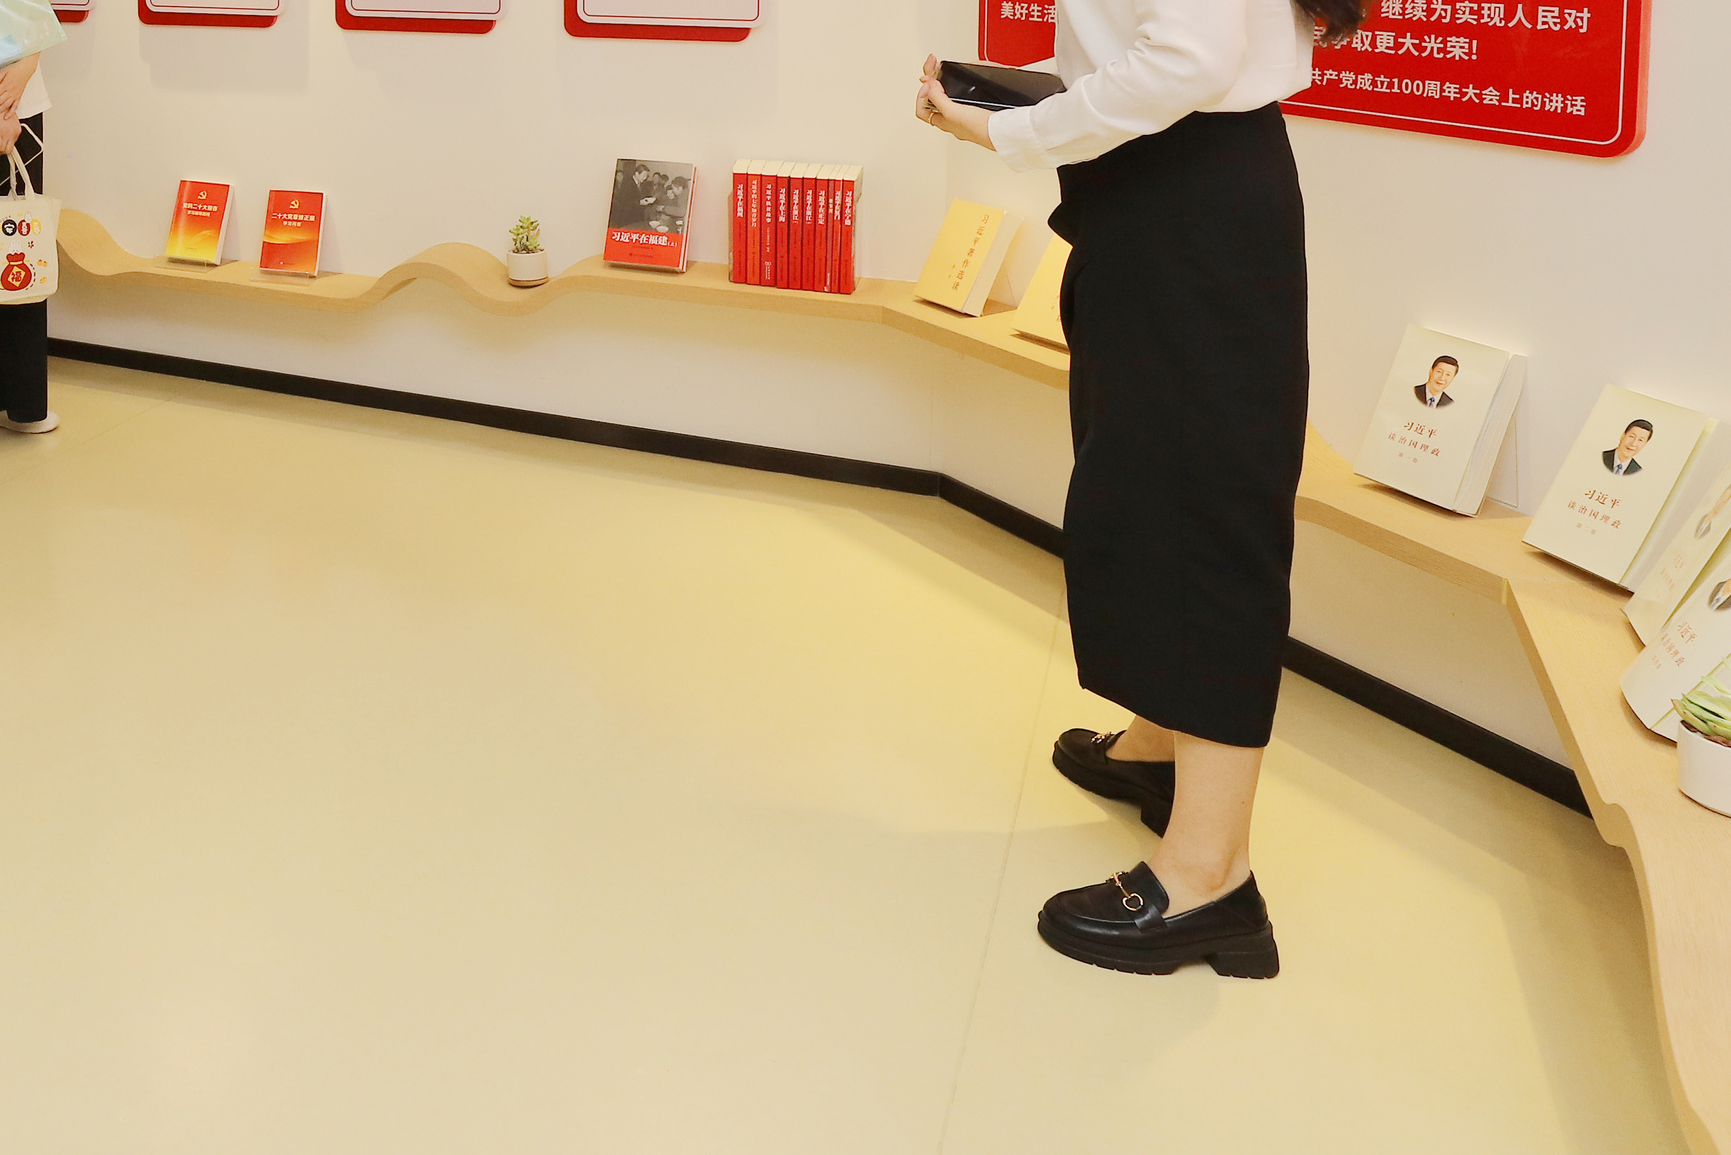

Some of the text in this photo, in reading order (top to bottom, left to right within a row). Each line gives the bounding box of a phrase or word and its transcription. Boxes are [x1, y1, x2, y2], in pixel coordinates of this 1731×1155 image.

[1001, 1, 1057, 23] 美好生活
[1312, 67, 1587, 116] 共产党成立100周年大会上的讲话
[11, 271, 22, 282] 福
[1404, 422, 1437, 438] 习近平
[1585, 490, 1621, 508] 习近平
